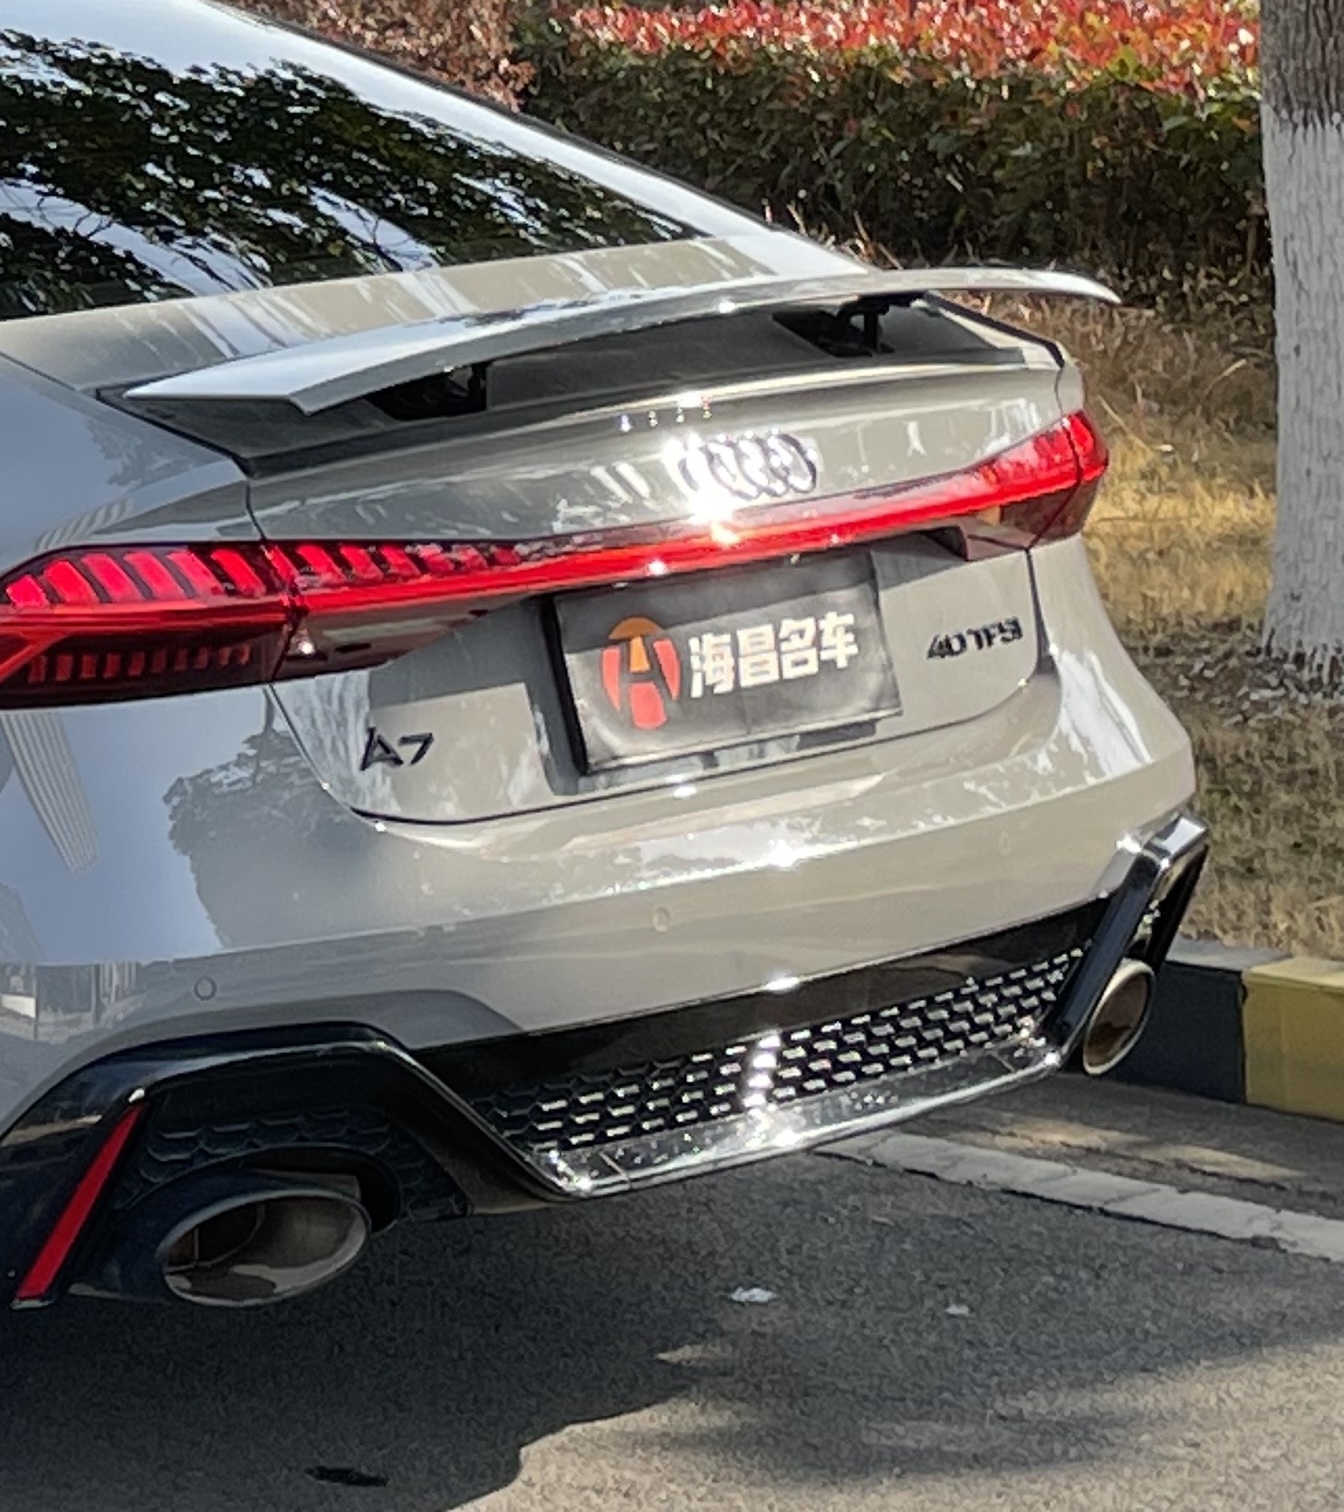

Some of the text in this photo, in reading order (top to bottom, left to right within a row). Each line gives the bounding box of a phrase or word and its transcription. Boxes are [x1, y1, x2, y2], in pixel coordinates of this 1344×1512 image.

[688, 611, 859, 698] 海昌名车
[359, 727, 435, 771] A7
